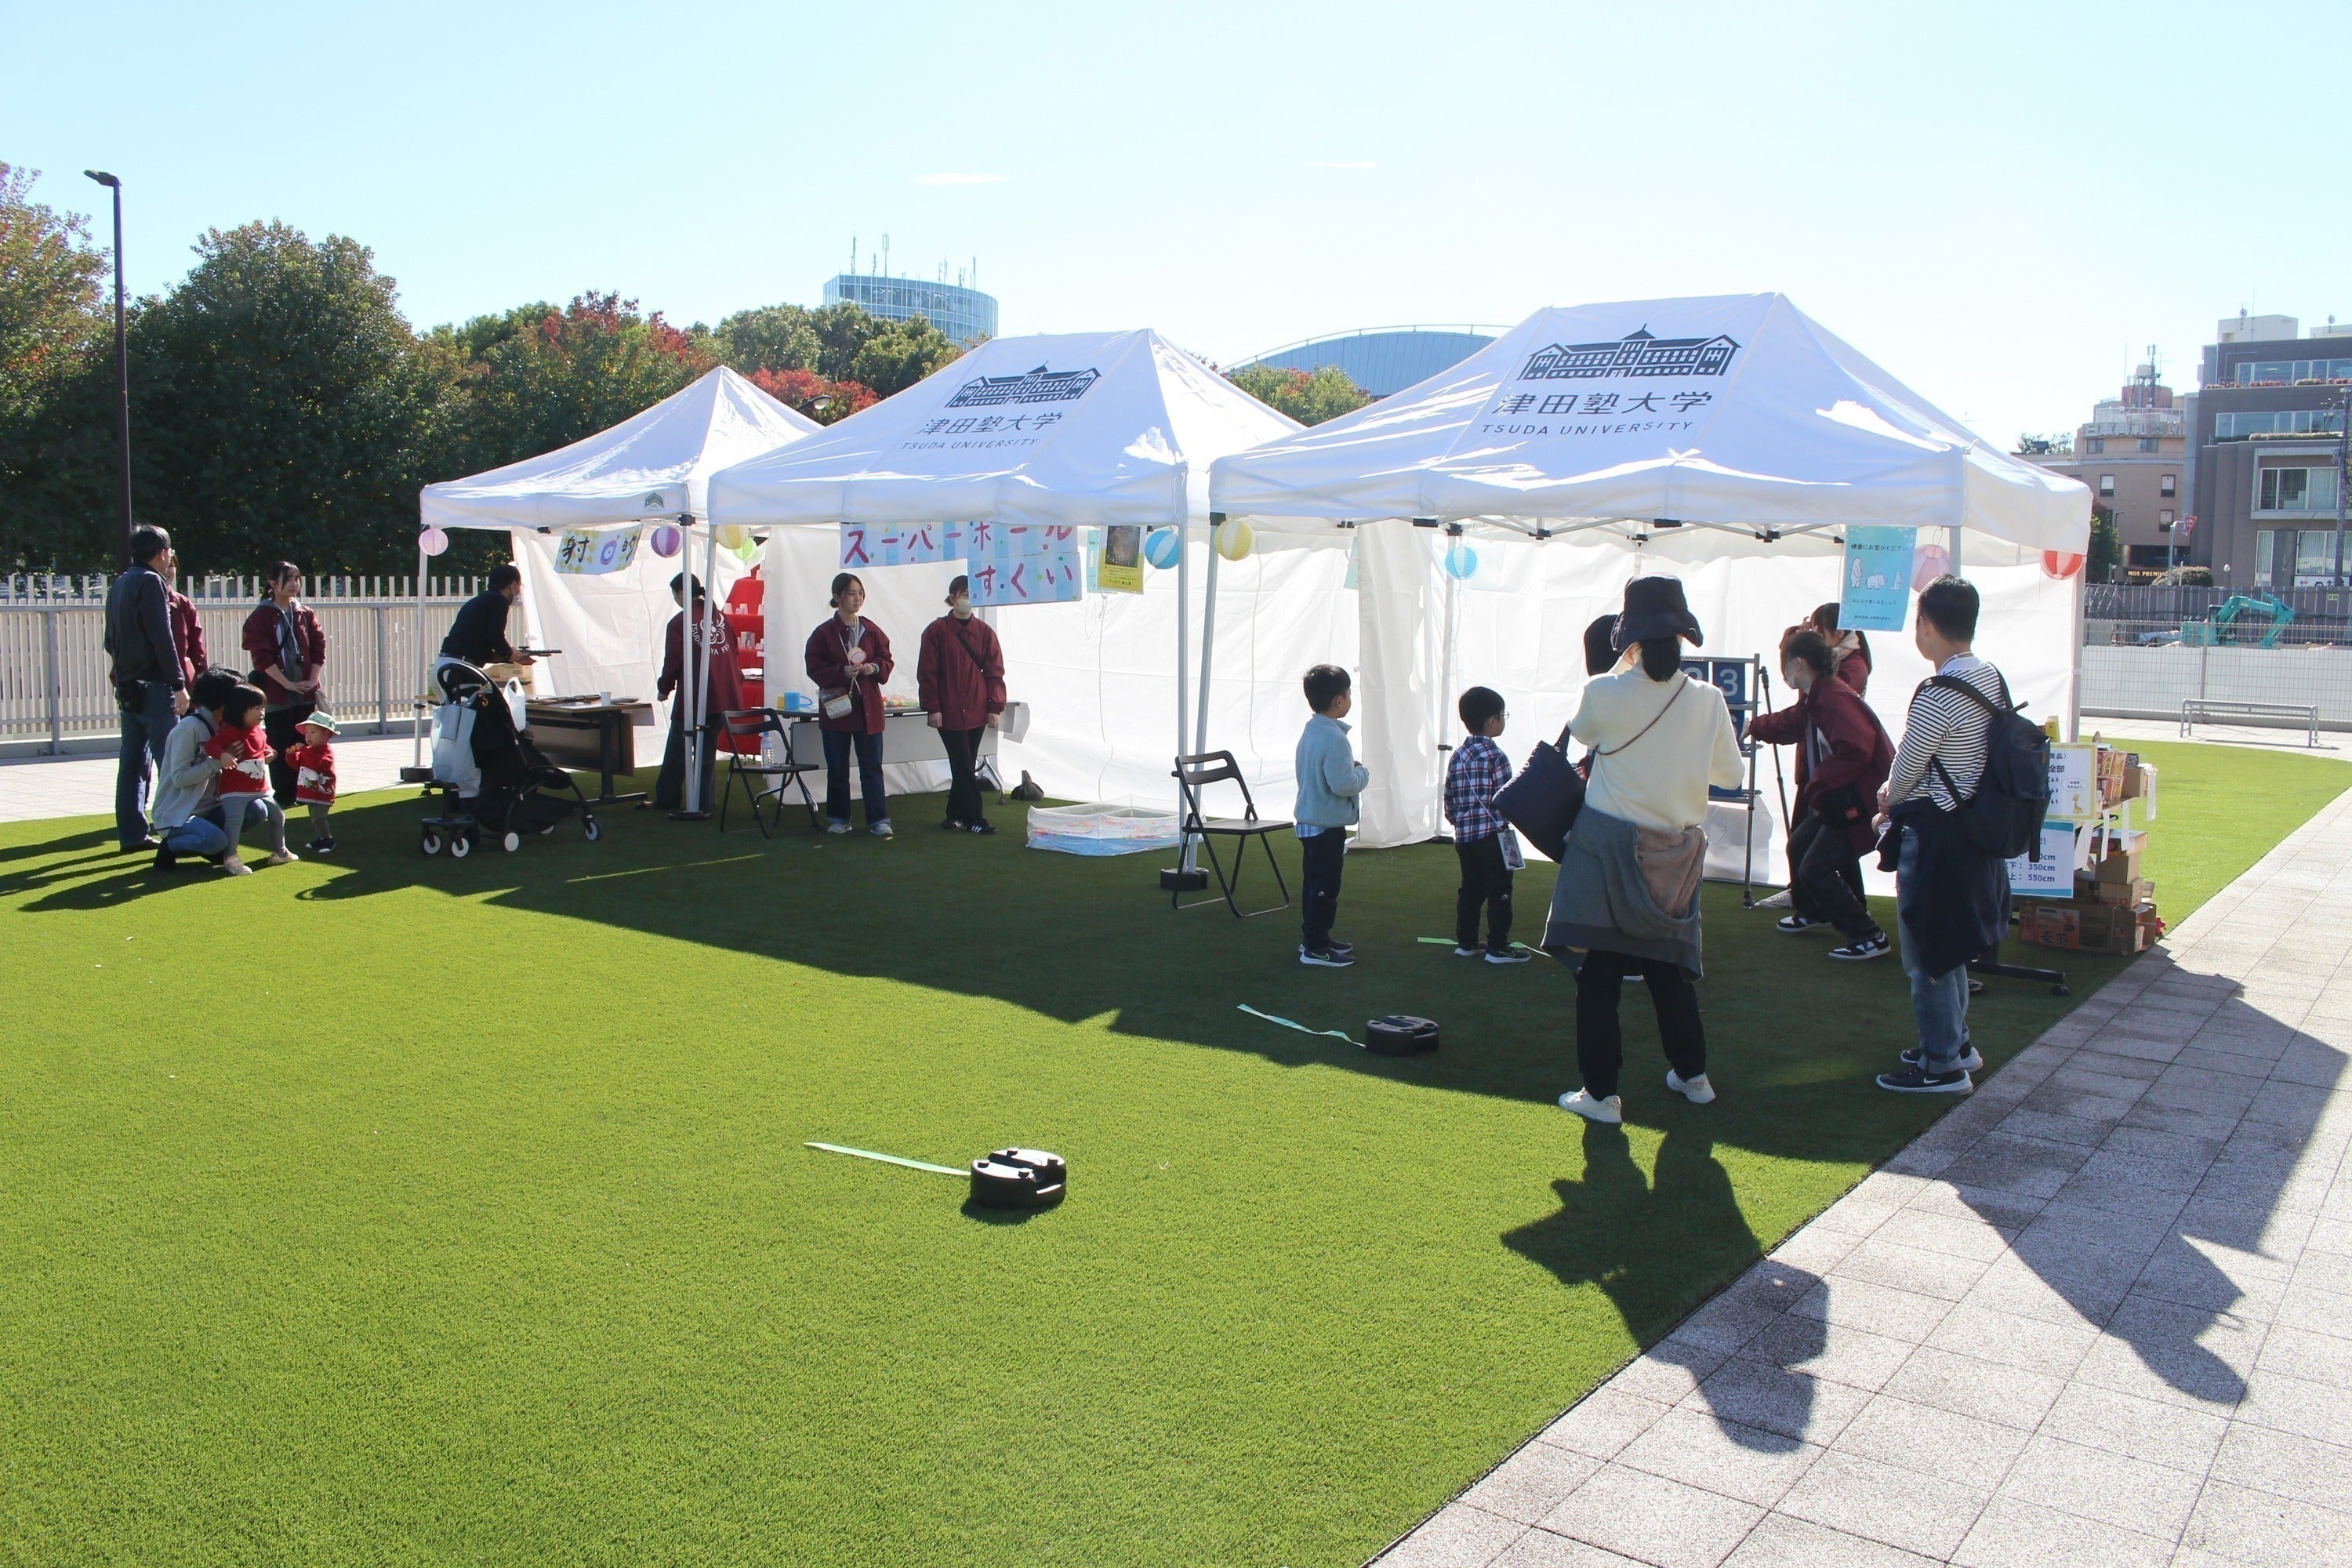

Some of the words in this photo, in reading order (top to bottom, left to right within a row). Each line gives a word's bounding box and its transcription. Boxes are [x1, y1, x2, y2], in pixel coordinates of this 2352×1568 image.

[1493, 391, 1713, 416] 津田塾大学
[916, 412, 1063, 435] 津田塾大学
[1483, 423, 1548, 435] TSUDA
[1560, 421, 1693, 435] UNIVERSITY
[902, 441, 945, 451] TSUDA
[951, 437, 1039, 450] UNIVERSITY
[975, 562, 1073, 598] すくい
[1719, 669, 1738, 697] 3
[2028, 863, 2056, 872] 350cm
